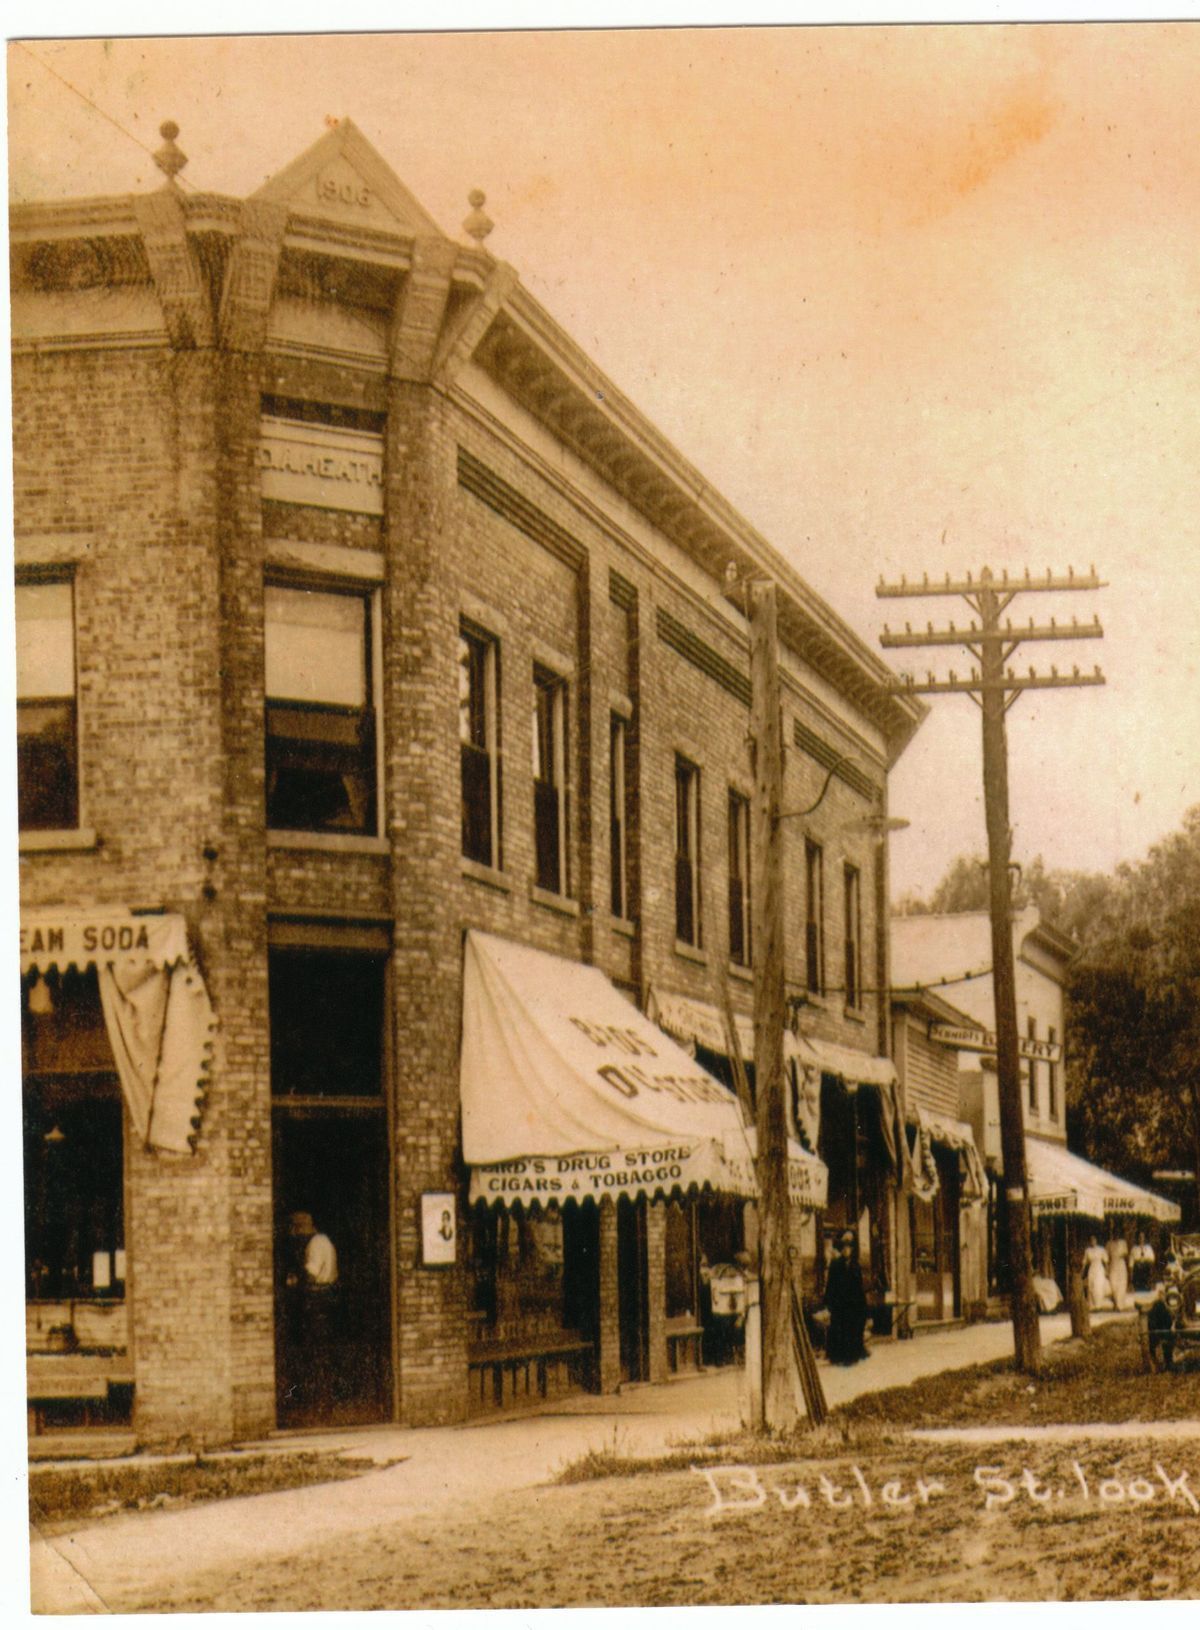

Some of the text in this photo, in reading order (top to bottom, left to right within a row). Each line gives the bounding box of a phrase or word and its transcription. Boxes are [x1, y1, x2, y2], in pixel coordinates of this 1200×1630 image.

[82, 924, 149, 951] SODA
[557, 1154, 611, 1173] DRUG
[625, 1146, 692, 1167] STORE
[488, 1177, 563, 1192] CIGARS
